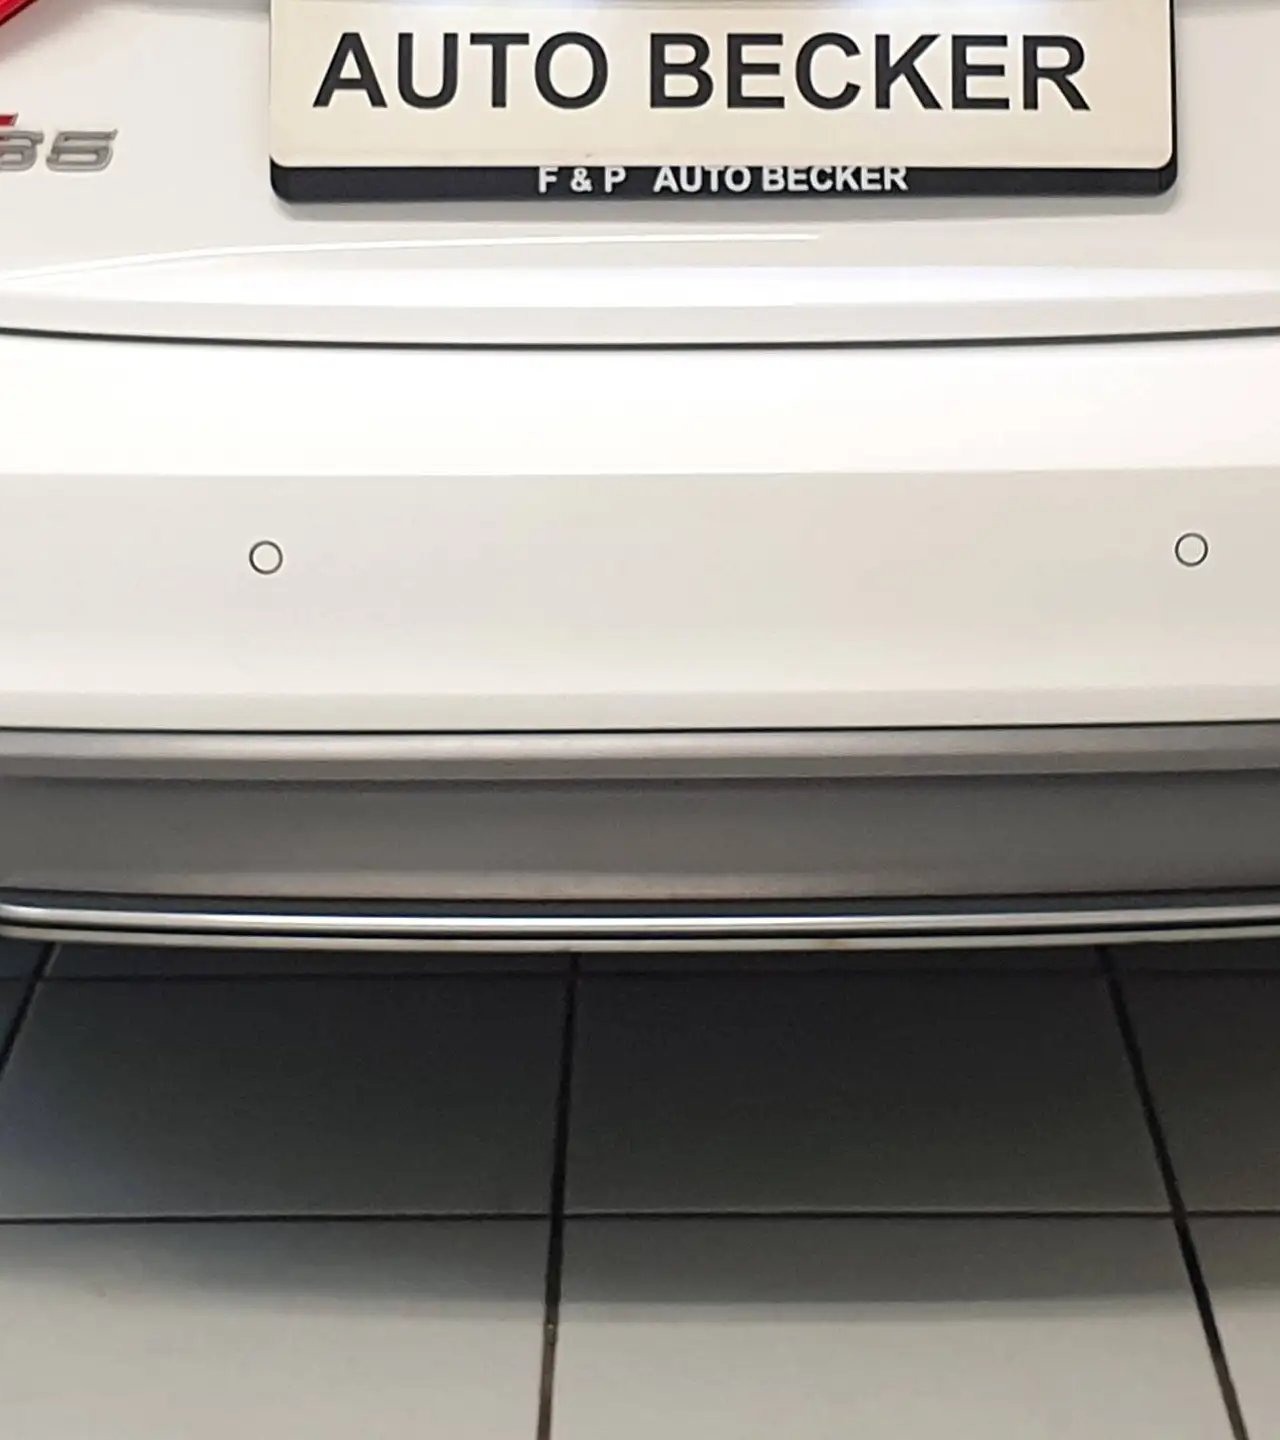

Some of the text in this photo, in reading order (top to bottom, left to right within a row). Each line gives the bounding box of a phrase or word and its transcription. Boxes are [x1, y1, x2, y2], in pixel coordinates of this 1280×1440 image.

[312, 31, 1091, 111] AUTO BECKER
[538, 166, 909, 193] F & P AUTO BECKER
